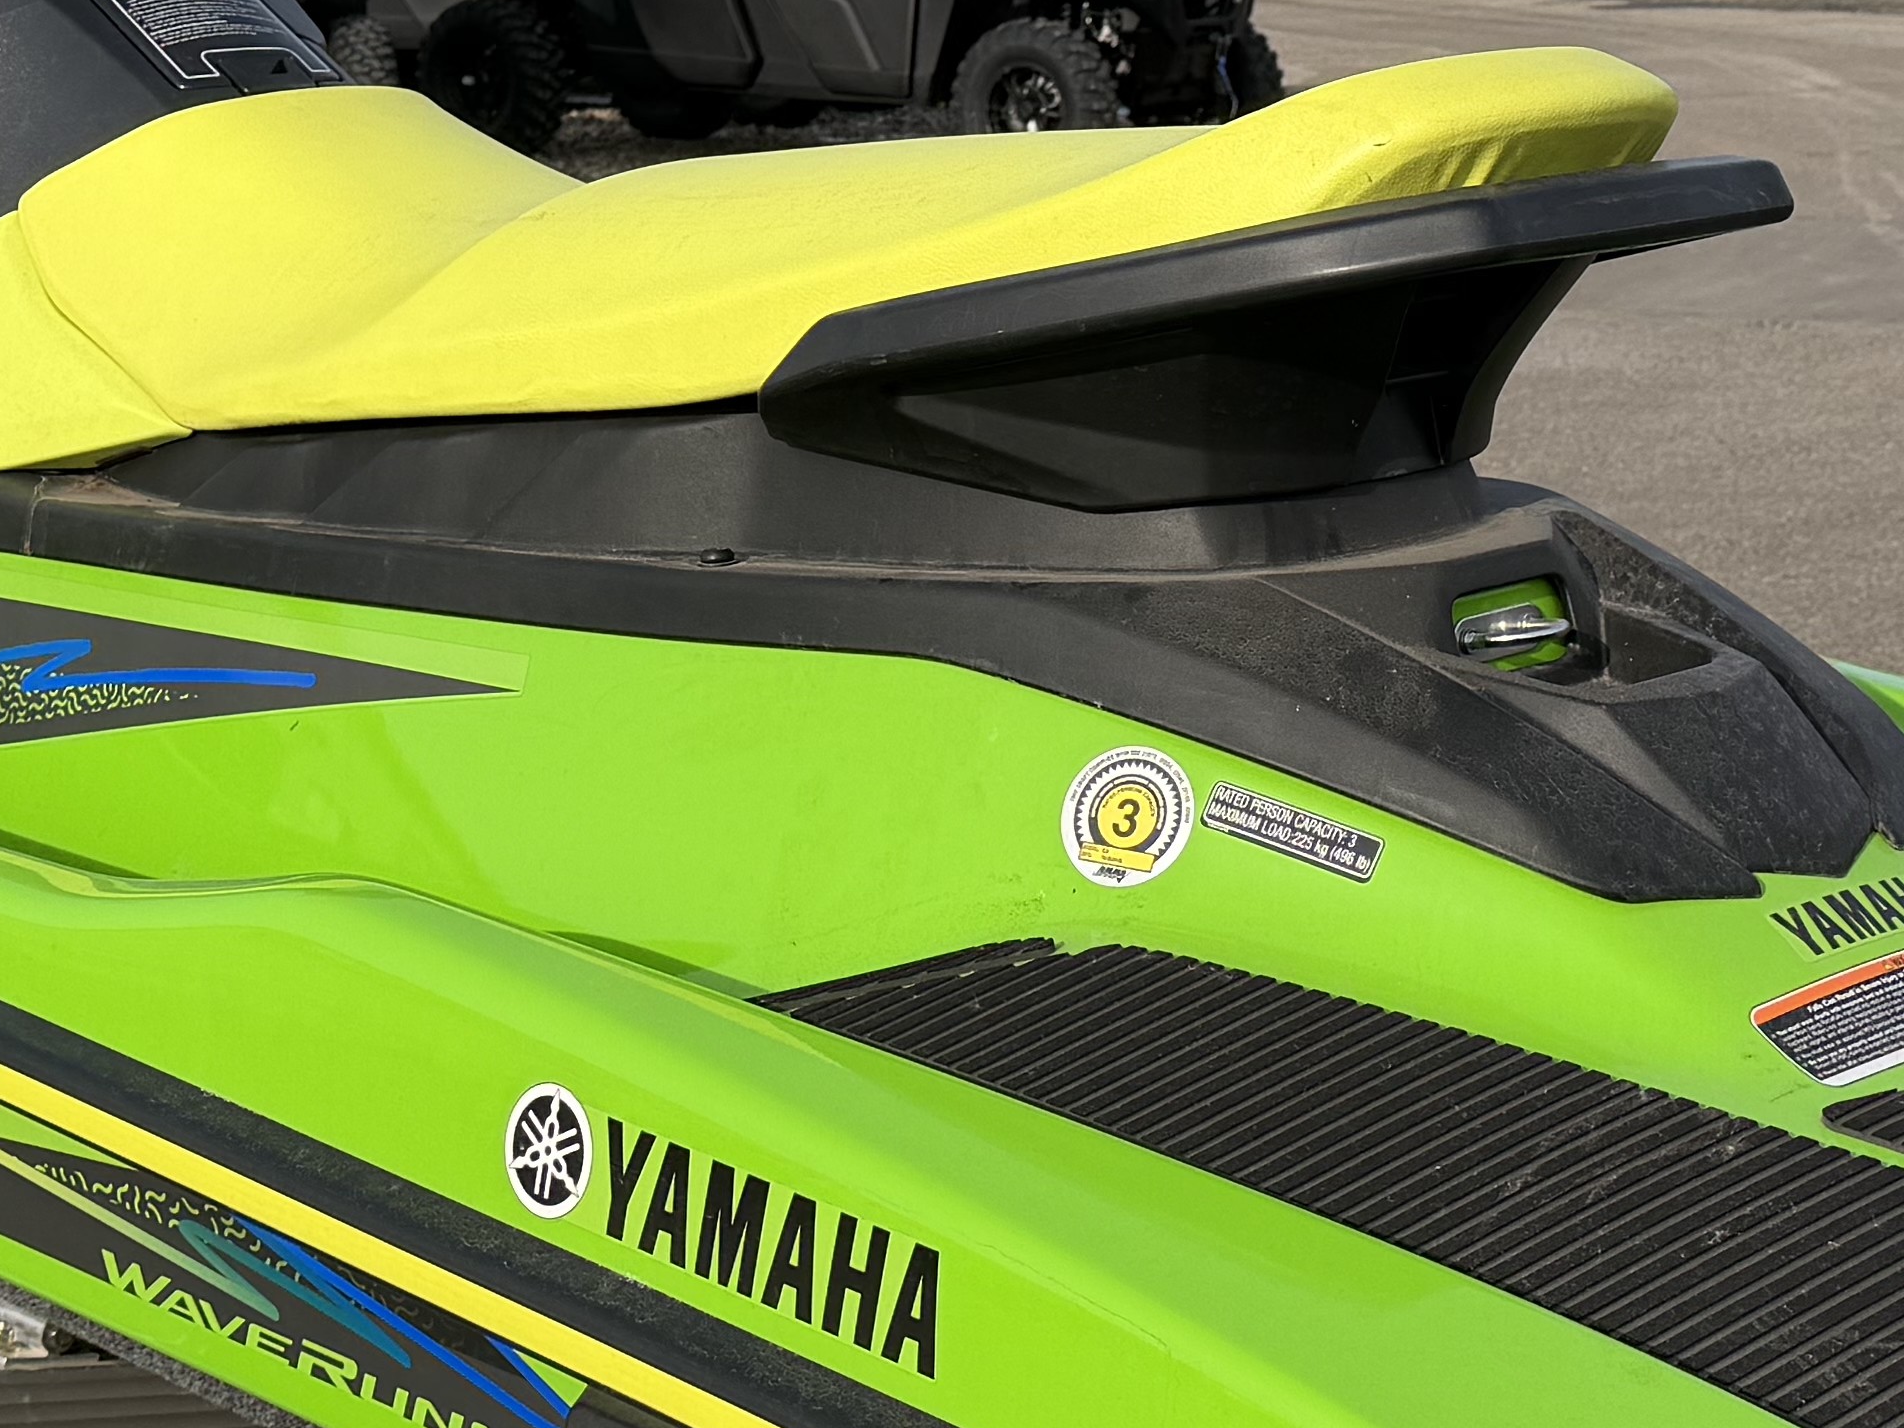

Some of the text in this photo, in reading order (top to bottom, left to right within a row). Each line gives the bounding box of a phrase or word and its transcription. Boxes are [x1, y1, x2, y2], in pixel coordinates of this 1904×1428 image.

[1112, 798, 1141, 838] 3
[1208, 802, 1261, 830] MAXIMUM
[1313, 839, 1329, 859] kg
[1329, 844, 1357, 866] (496
[1356, 852, 1371, 873] lb)
[1215, 785, 1357, 848] RATED PERSON CAPACITY: 3
[606, 1116, 941, 1381] YAMAHA
